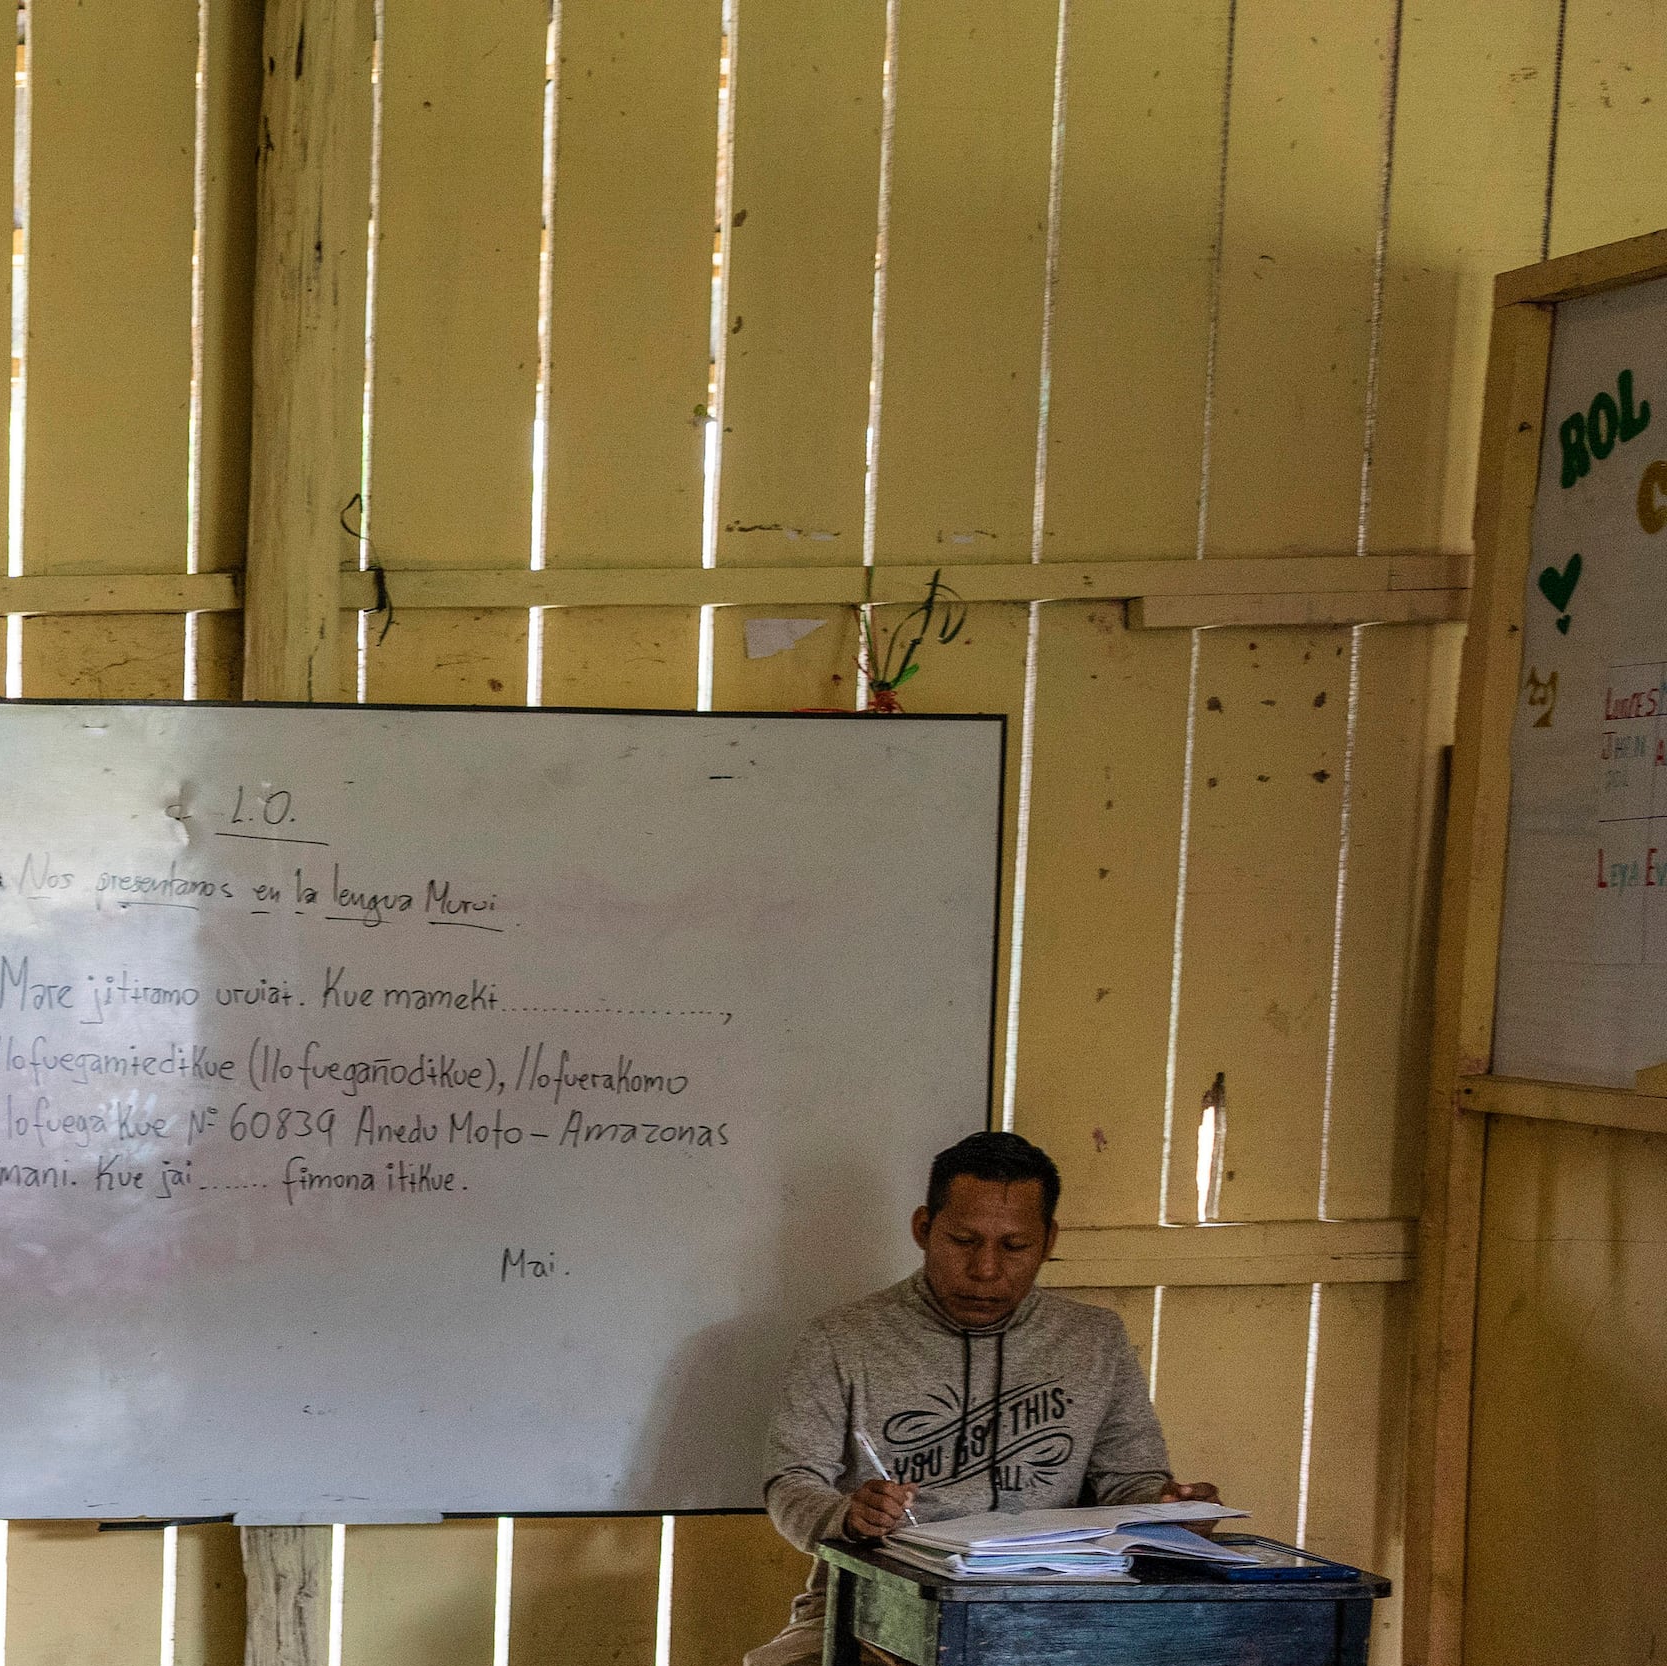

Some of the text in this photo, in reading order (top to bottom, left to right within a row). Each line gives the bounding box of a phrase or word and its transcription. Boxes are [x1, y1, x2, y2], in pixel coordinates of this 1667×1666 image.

[1560, 369, 1651, 488] ROL
[18, 851, 75, 895] Nos
[252, 886, 281, 904] en
[294, 867, 319, 904] la
[332, 862, 414, 928] lengua
[322, 966, 375, 1009] Kue
[229, 1102, 336, 1148] 60839
[354, 1104, 439, 1147] Anedu
[448, 1108, 524, 1150] Moto
[558, 1108, 730, 1149] Amazonas
[96, 1154, 144, 1191] Kue
[893, 1445, 943, 1486] YOU
[1009, 1386, 1067, 1436] THIS
